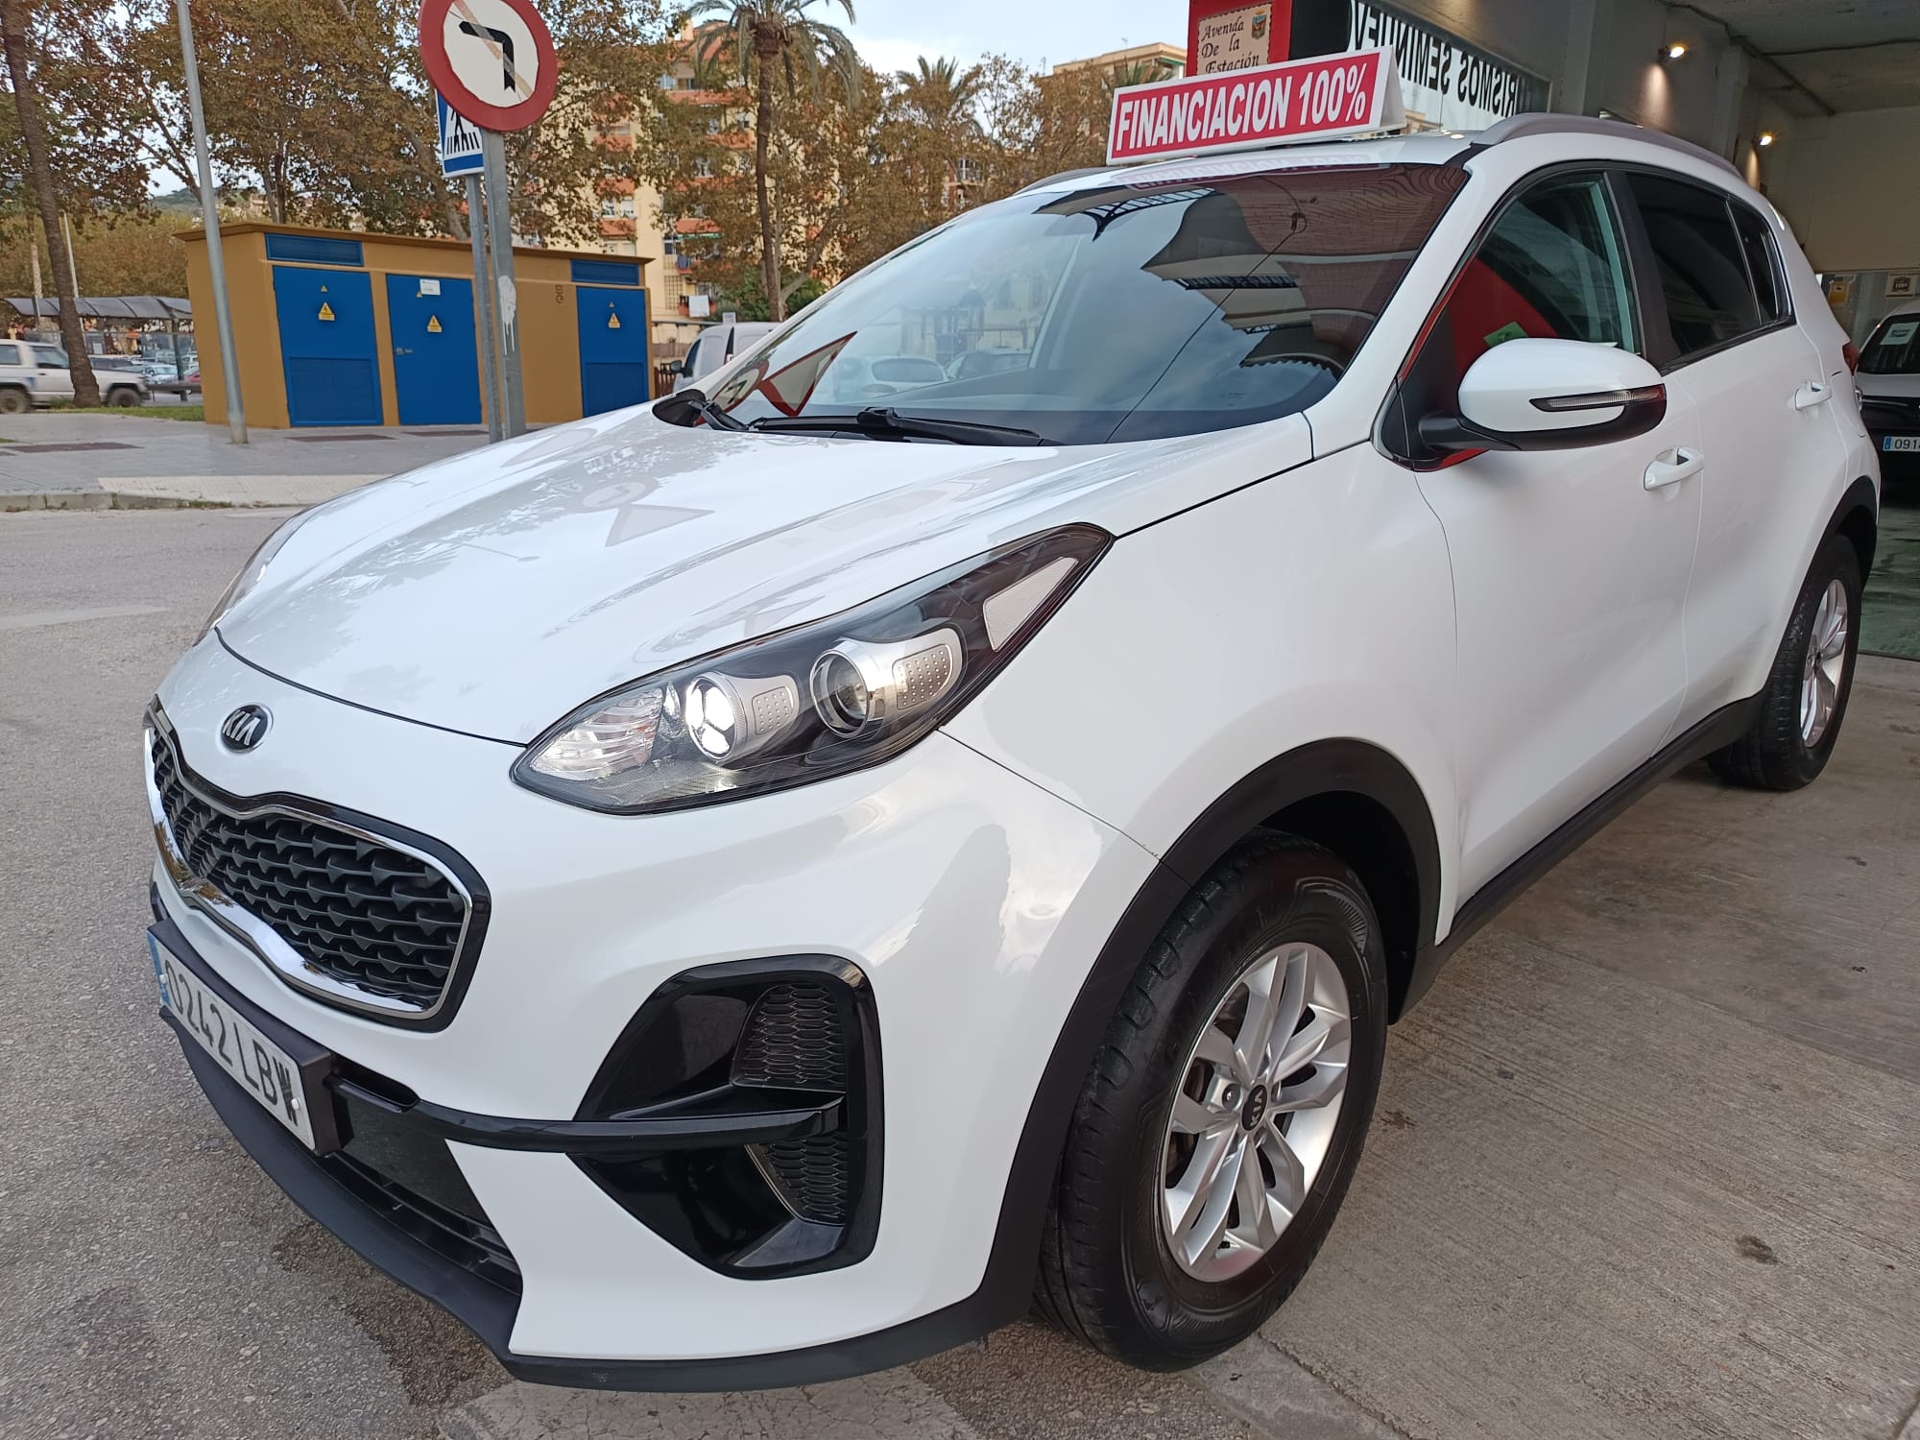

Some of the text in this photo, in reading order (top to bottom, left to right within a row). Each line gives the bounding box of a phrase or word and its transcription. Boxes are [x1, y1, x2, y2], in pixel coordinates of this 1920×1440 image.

[1201, 15, 1244, 42] Avenida
[1201, 33, 1240, 59] De la
[1205, 51, 1260, 74] Estación
[1116, 62, 1368, 151] FINANCIACION 100%
[1894, 438, 1920, 450] 091
[222, 709, 261, 746] KIA
[164, 959, 233, 1067] 0242
[1249, 1089, 1264, 1128] KIA
